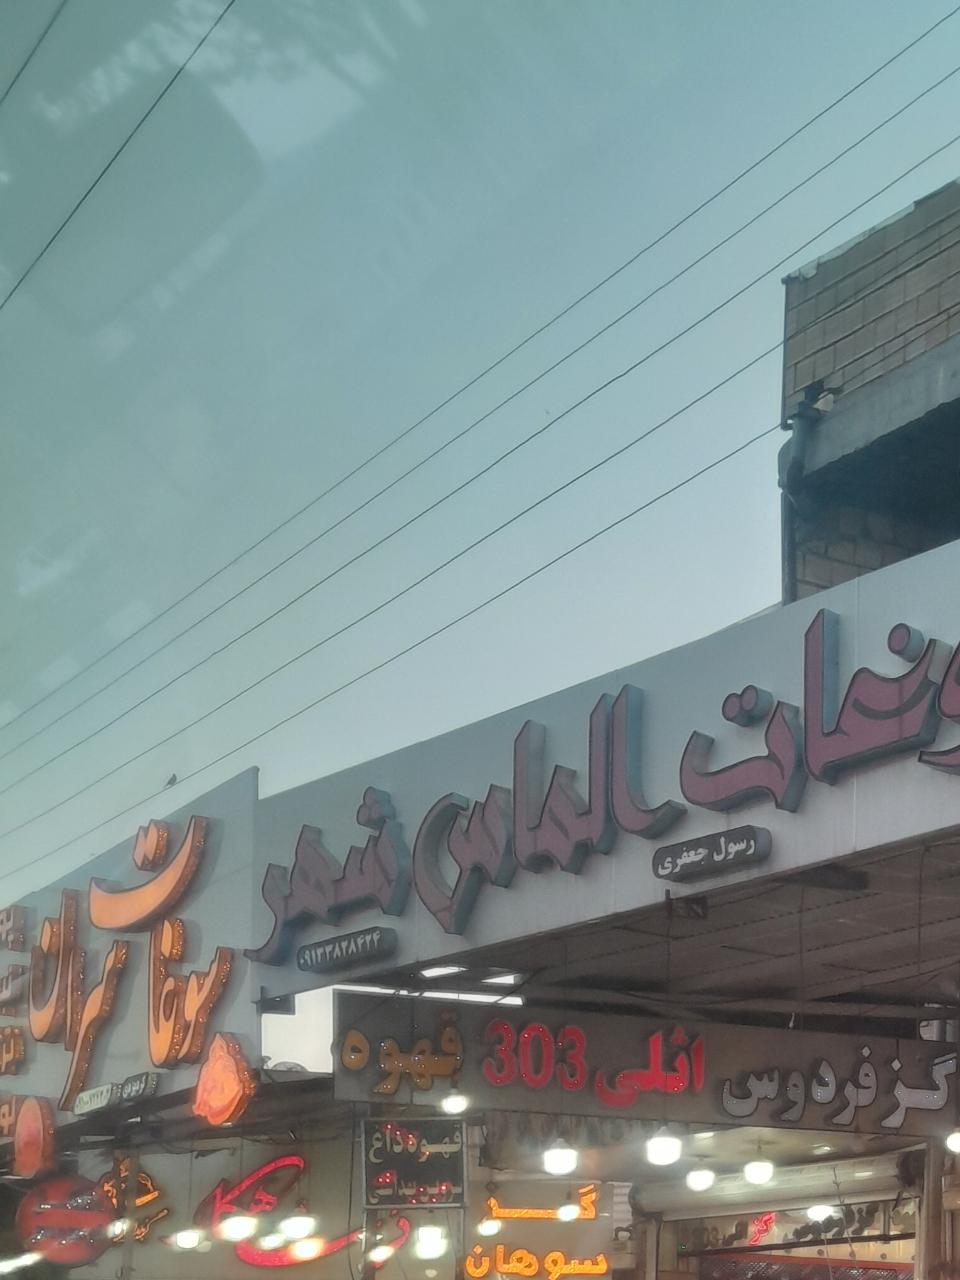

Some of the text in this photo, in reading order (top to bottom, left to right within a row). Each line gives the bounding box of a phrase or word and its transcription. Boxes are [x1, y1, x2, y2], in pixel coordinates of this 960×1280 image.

[412, 684, 688, 935] الماس
[242, 787, 412, 966] شهر
[657, 835, 757, 876] رسول جعفری
[88, 814, 236, 1069] سوغات
[340, 1008, 464, 1096] قهوه
[481, 1018, 588, 1091] 303
[721, 1045, 878, 1126] فردوس
[880, 1052, 958, 1129] گز
[368, 1123, 462, 1164] قهوه داغ
